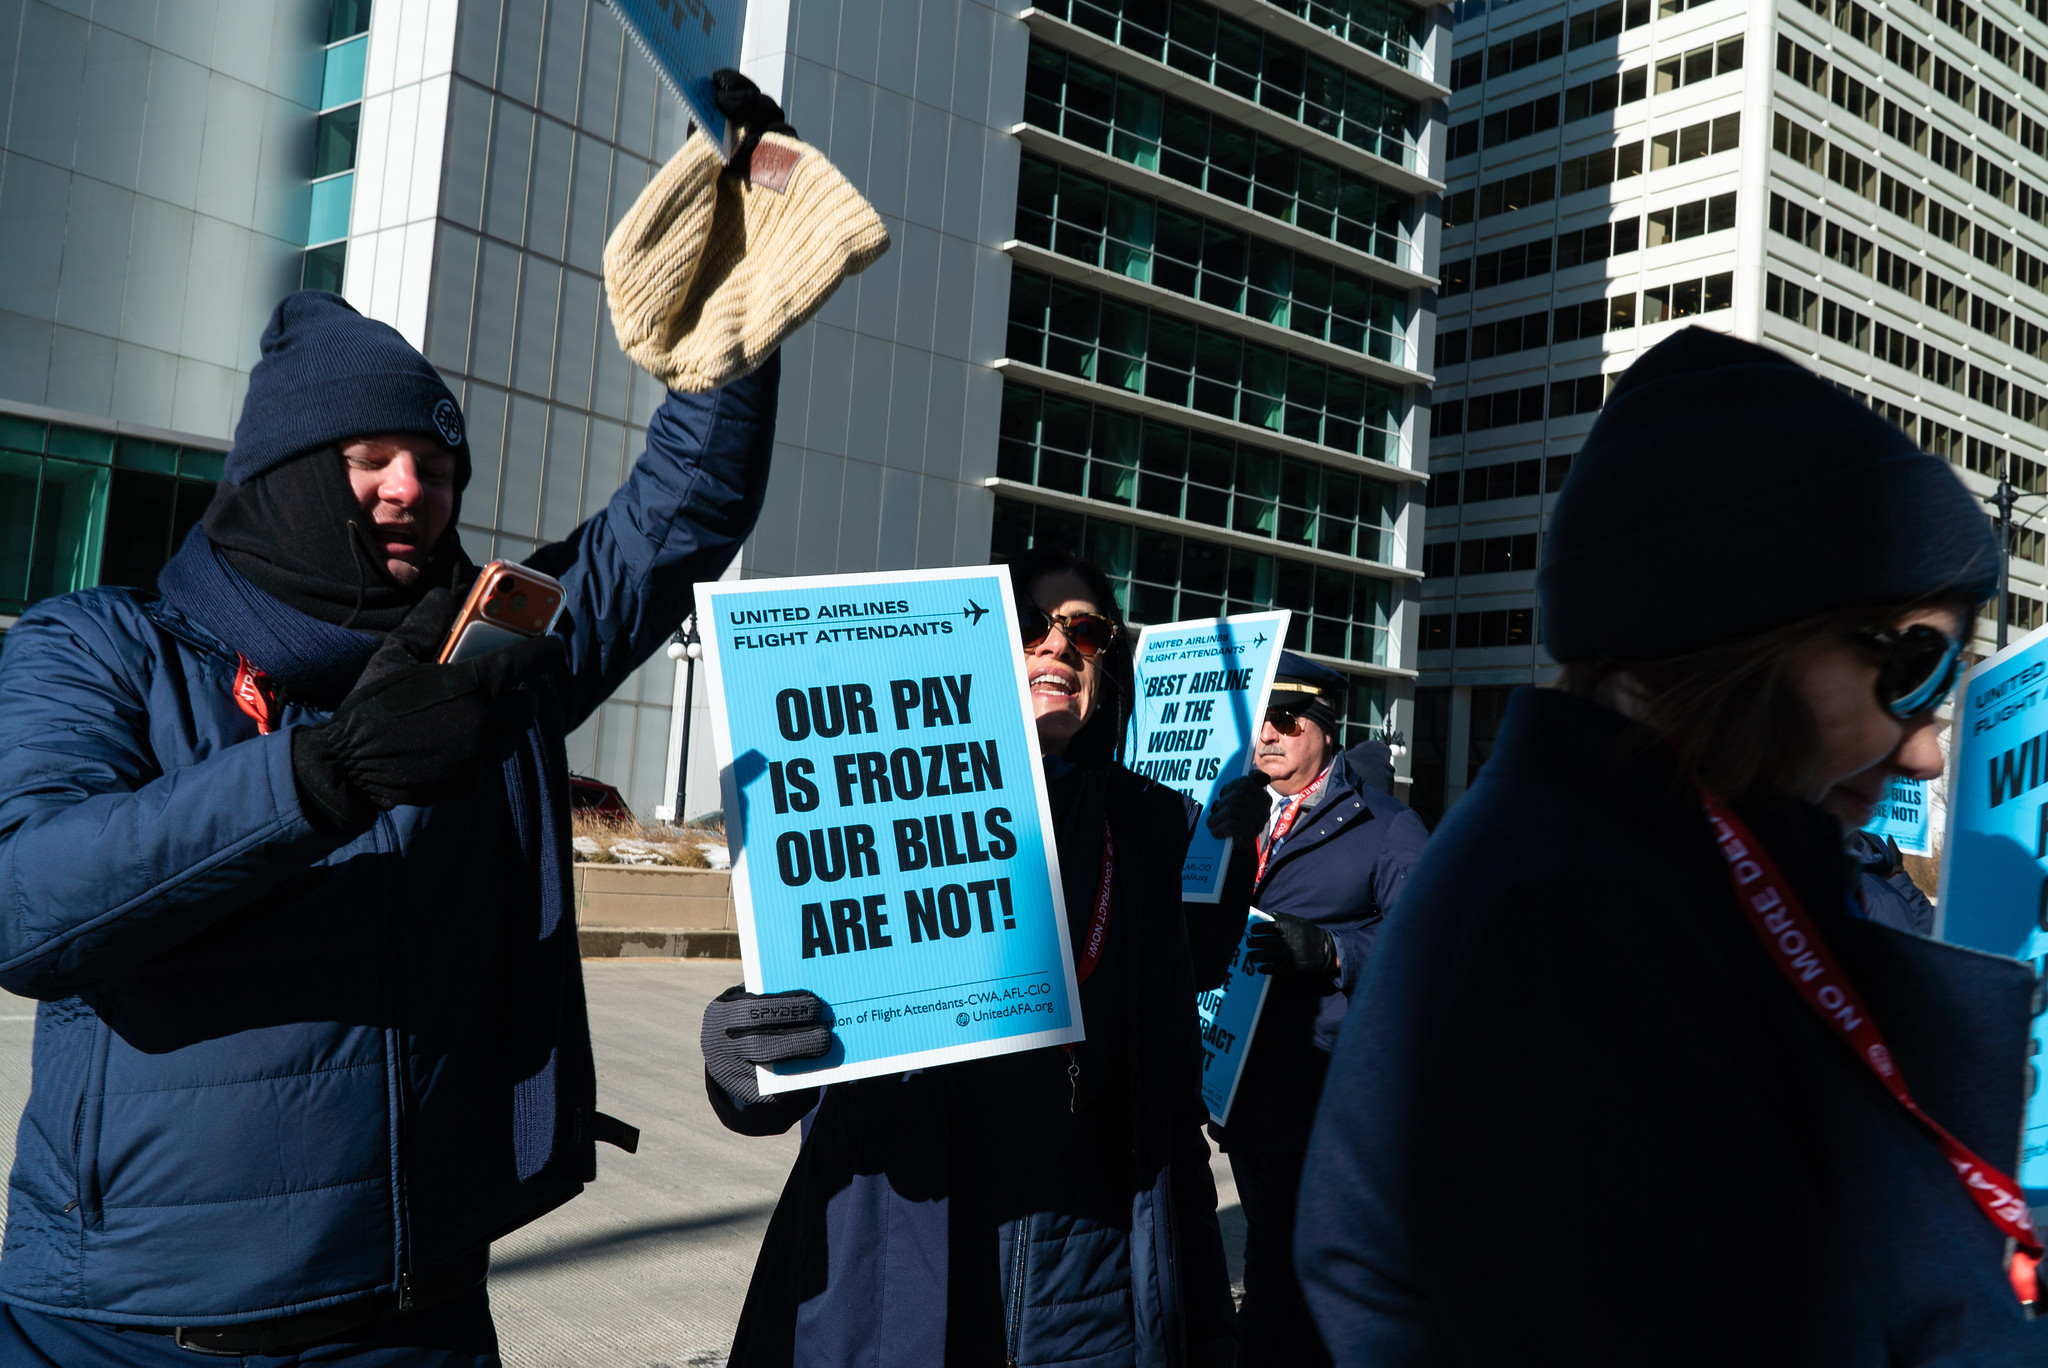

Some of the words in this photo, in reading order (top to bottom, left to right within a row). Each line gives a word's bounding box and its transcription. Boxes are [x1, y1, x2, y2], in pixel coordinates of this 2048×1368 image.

[730, 607, 810, 625] UNITED
[818, 600, 909, 620] AIRLINES
[733, 632, 808, 650] FLIGHT
[815, 621, 953, 644] ATTENDANTS
[1149, 639, 1183, 650] UNITED
[1184, 633, 1229, 647] AIRLINES
[1144, 652, 1178, 663] FLIGHT
[1178, 646, 1245, 660] ATTENDANTS
[1188, 668, 1253, 694] AIRLINE
[1975, 661, 2046, 709] UNITED
[775, 682, 878, 741] OUR
[890, 673, 972, 731] PAY
[1160, 702, 1180, 724] IN
[1183, 699, 1215, 722] THE
[768, 757, 820, 815] IS
[833, 739, 1004, 807] FROZEN
[1136, 758, 1191, 782] EAVING
[1195, 757, 1221, 781] US
[1891, 788, 1921, 806] BILLS
[1891, 806, 1919, 824] NOT!
[776, 823, 880, 887] OUR
[893, 806, 1018, 873] BILLS
[1098, 861, 1113, 924] CONTRACT
[801, 893, 893, 960] ARE
[905, 877, 1017, 944] NOT!
[1088, 923, 1103, 958] NOW!
[750, 1004, 810, 1020] SPYDER
[856, 1010, 868, 1024] of
[871, 1007, 901, 1023] Flight
[972, 1001, 1054, 1022] UnitedAFA.org
[1817, 984, 1863, 1032] NO
[1199, 1016, 1236, 1054] RACT
